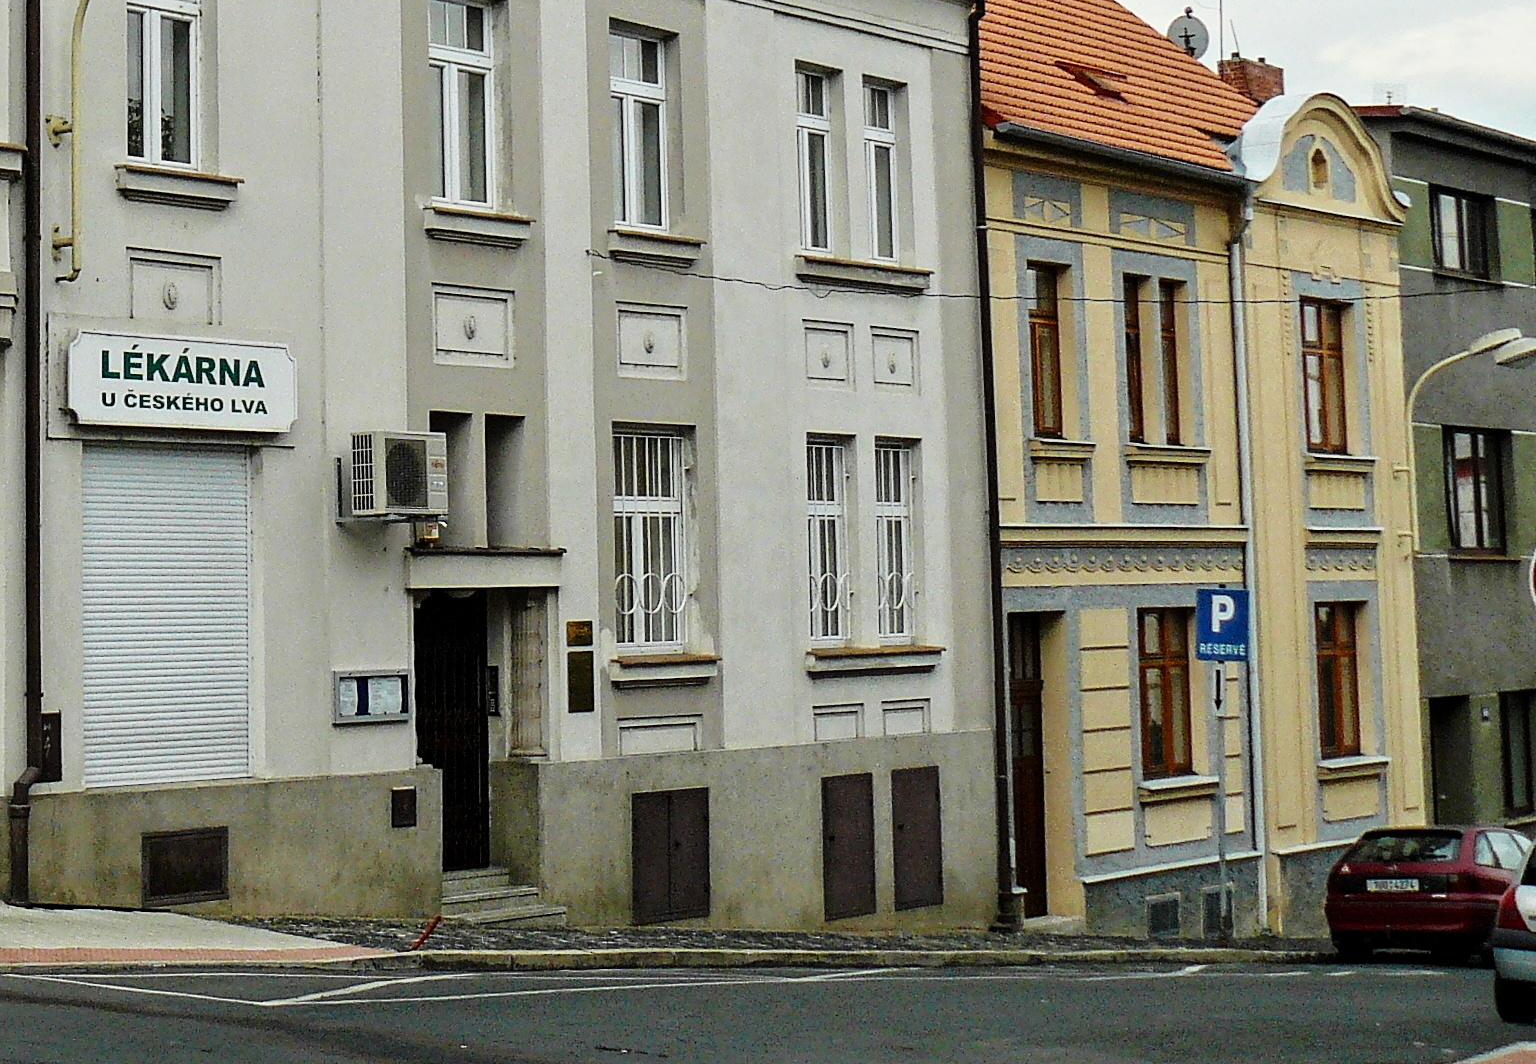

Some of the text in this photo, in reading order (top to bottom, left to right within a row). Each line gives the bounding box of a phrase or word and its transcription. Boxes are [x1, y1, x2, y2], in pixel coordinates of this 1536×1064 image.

[101, 344, 265, 388] LÉKÁRNA
[101, 389, 268, 414] U ČESKÉHO LVA
[1211, 594, 1235, 633] P
